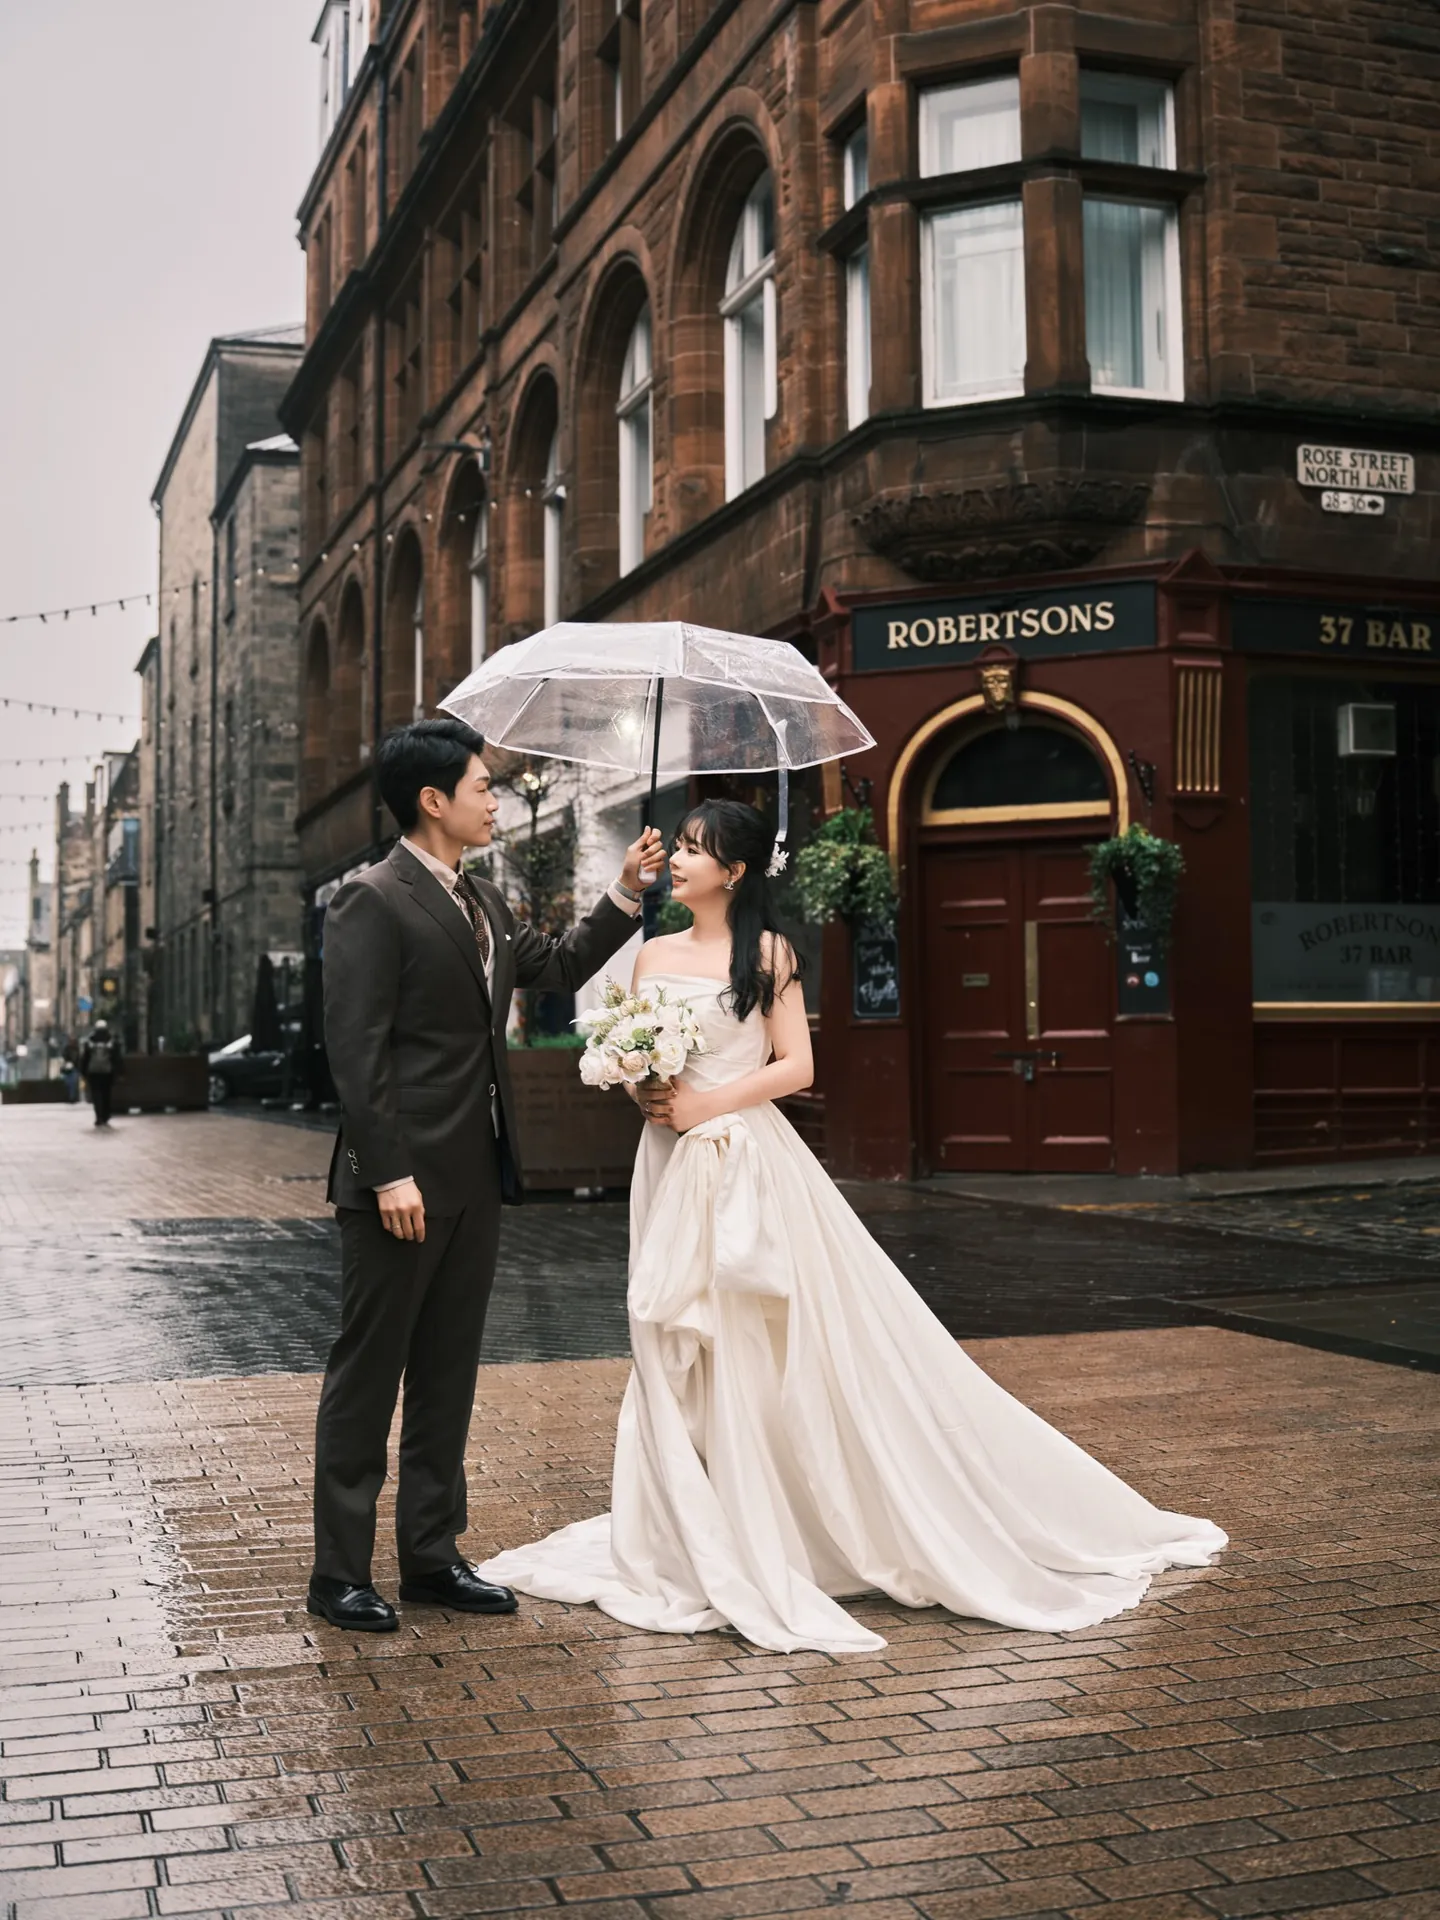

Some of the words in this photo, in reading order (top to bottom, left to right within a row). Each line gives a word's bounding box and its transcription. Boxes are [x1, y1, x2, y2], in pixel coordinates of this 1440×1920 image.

[1302, 448, 1343, 467] ROSE
[1349, 452, 1409, 473] STREET
[1304, 467, 1360, 487] NORTH
[1366, 473, 1408, 491] LANE
[887, 601, 1115, 649] ROBERTSONS
[1319, 614, 1354, 645] 37
[1366, 619, 1432, 651] BAR
[1340, 943, 1363, 964] 37
[1369, 944, 1413, 964] BAR
